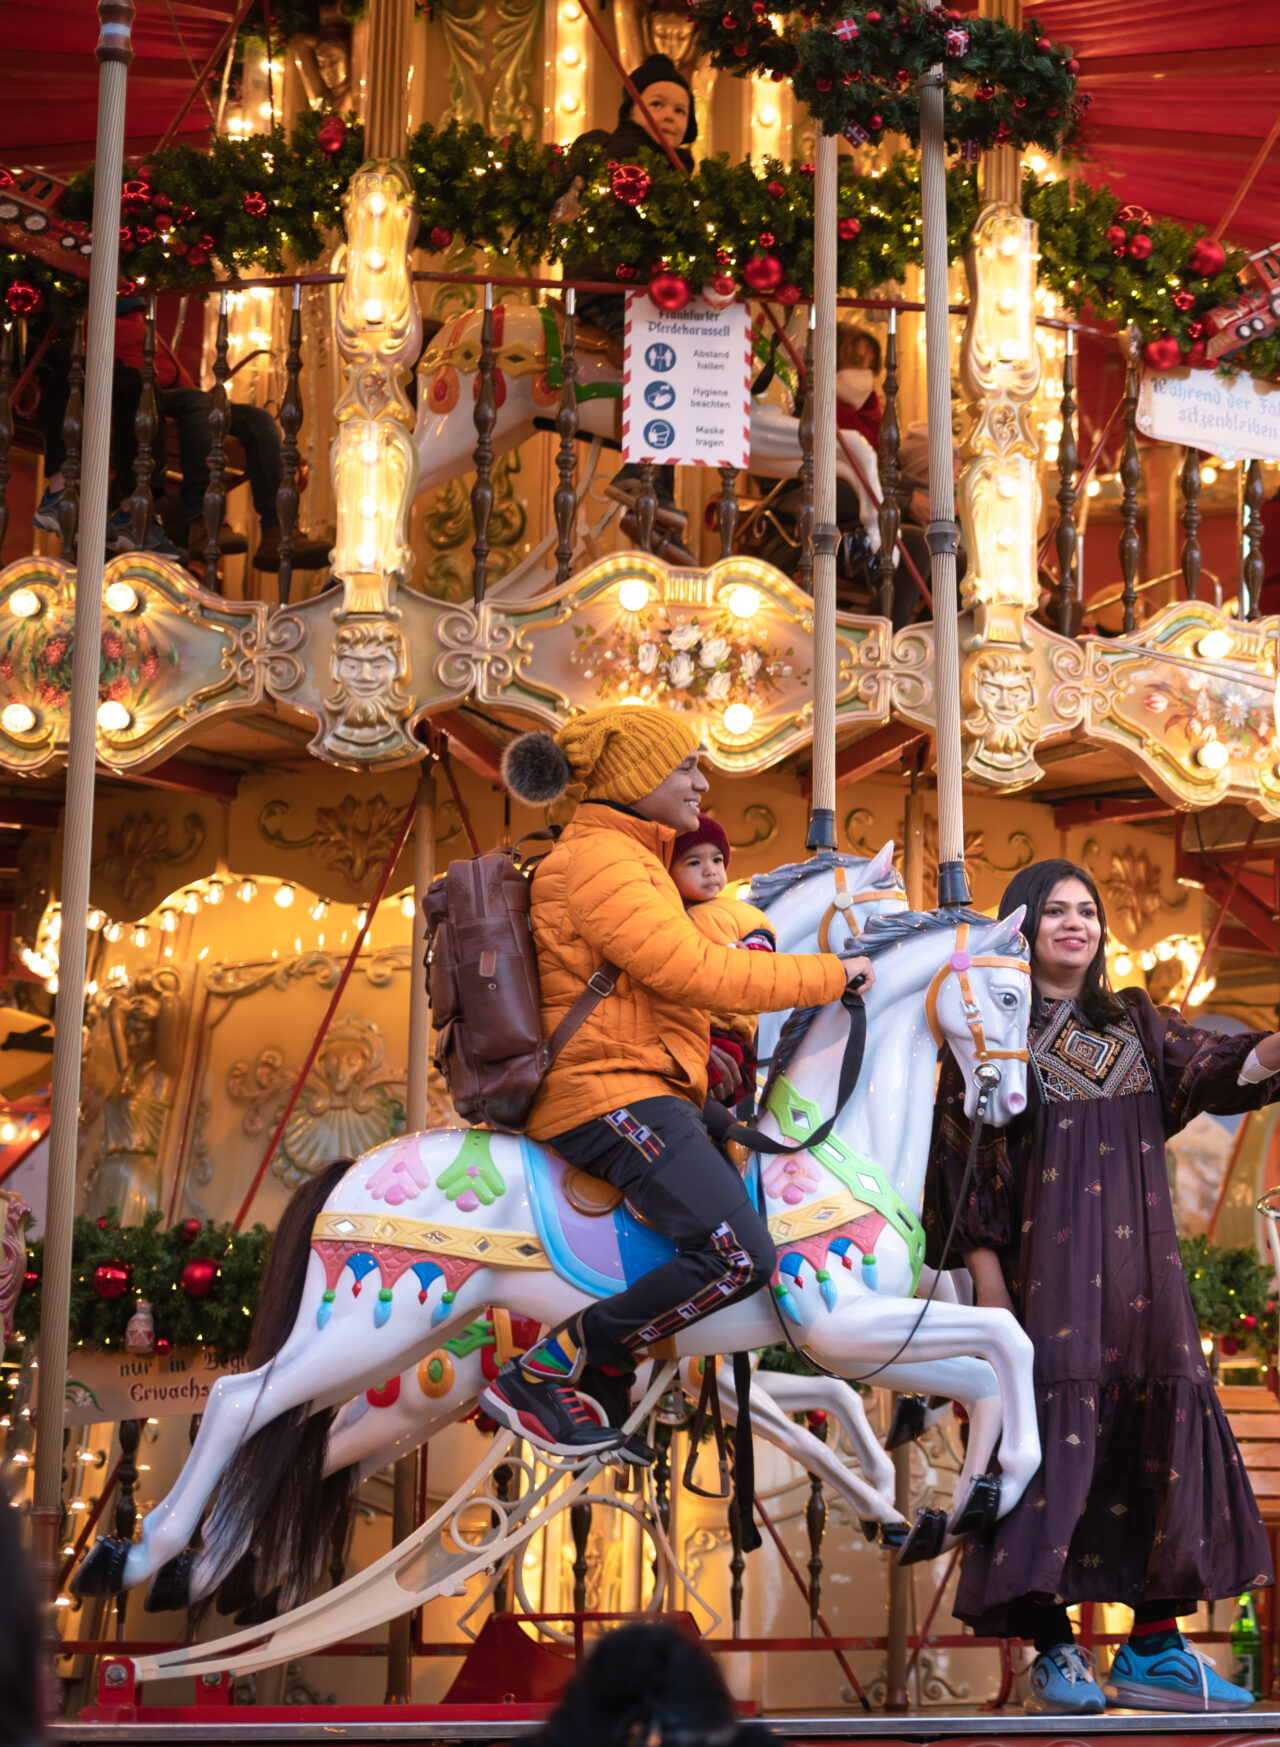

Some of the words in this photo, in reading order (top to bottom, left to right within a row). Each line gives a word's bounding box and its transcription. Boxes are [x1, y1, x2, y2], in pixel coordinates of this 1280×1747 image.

[647, 320, 730, 337] Pferdekarussell
[693, 349, 729, 359] Abstand
[697, 361, 725, 371] halten
[693, 387, 728, 397] Hygiene
[690, 400, 730, 409] beachten
[1226, 390, 1252, 411] der
[696, 426, 724, 435] Maske
[696, 439, 724, 448] tragen
[120, 1360, 152, 1377] nur
[169, 1355, 186, 1373] in
